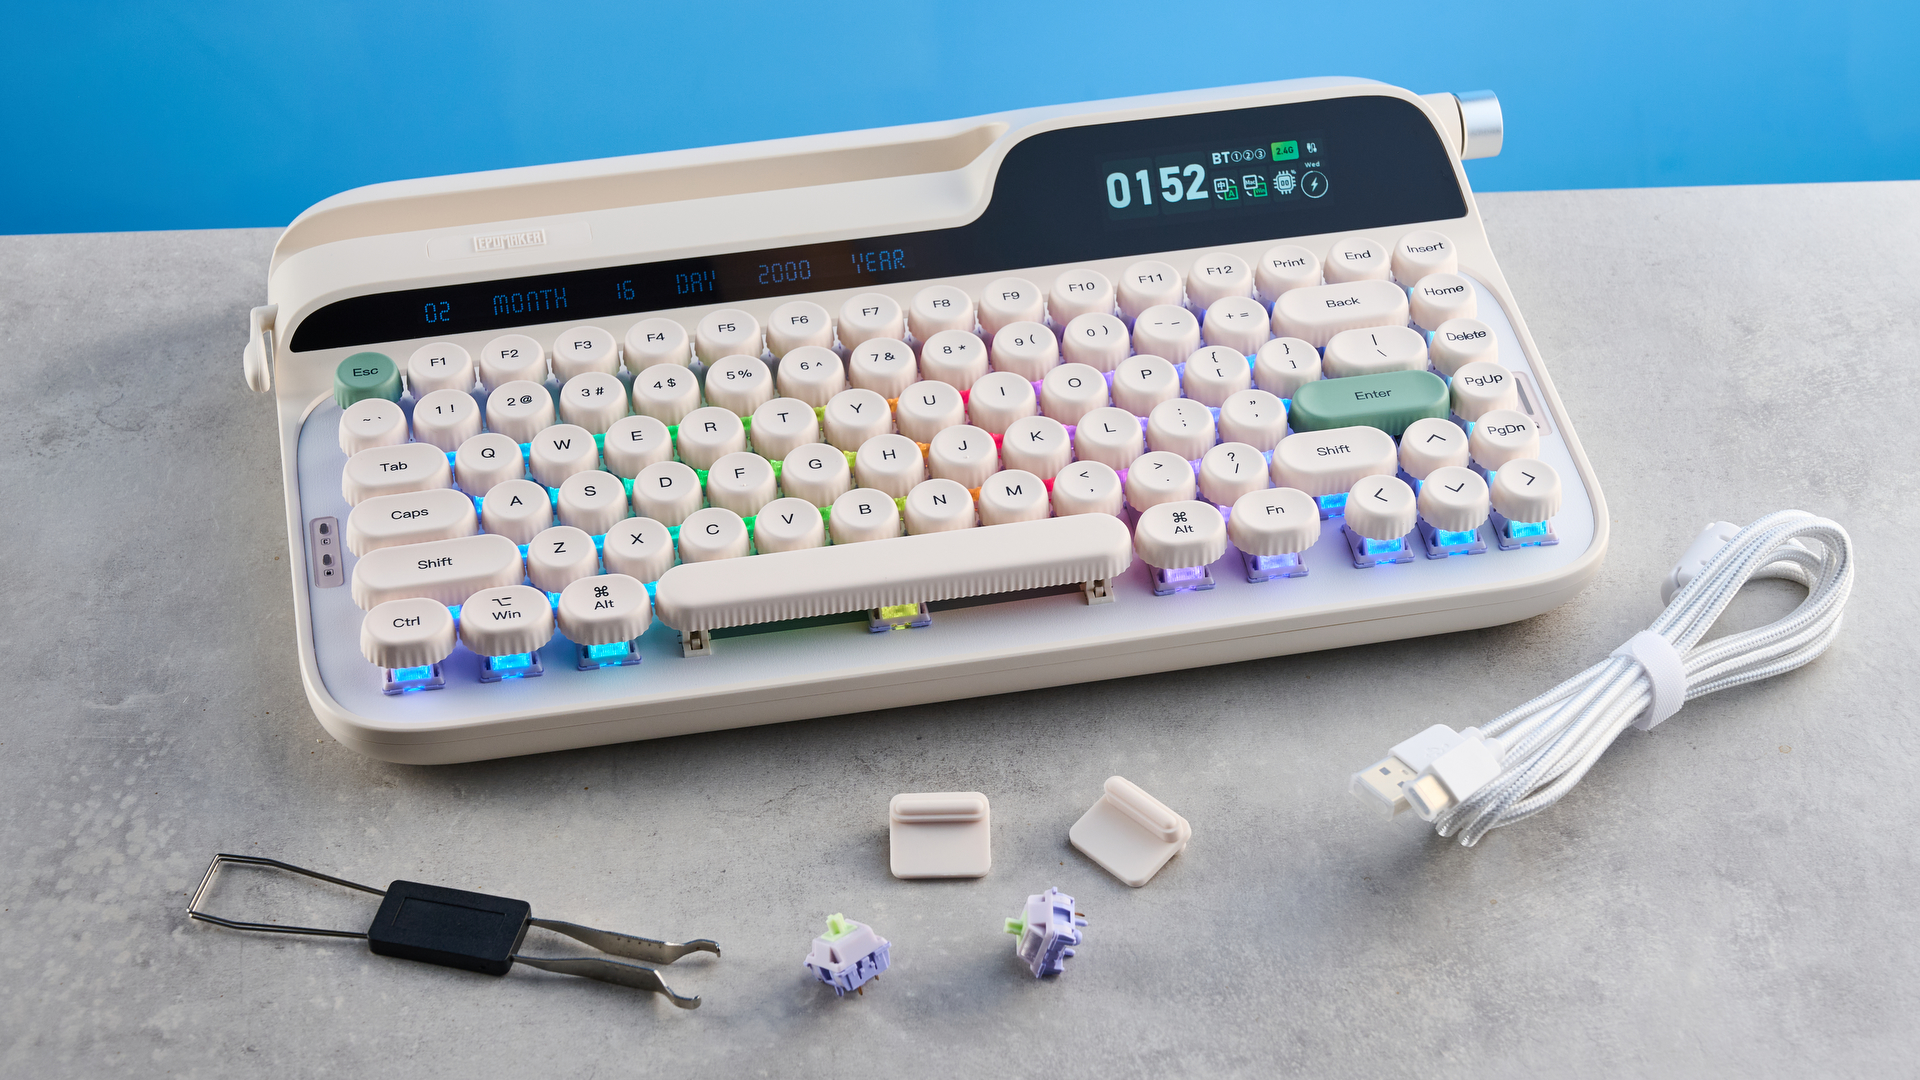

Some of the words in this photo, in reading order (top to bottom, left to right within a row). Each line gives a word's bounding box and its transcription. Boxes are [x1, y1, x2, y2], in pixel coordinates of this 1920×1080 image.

[1276, 146, 1294, 155] 2.4G
[1106, 164, 1209, 209] 0152
[1228, 190, 1235, 198] A
[1406, 241, 1444, 253] Insert
[1344, 249, 1372, 260] End
[1272, 257, 1306, 268] Print
[1206, 265, 1233, 276] F12
[1138, 273, 1163, 284] F11
[424, 301, 450, 323] 02
[493, 287, 568, 316] MONTH
[616, 280, 635, 300] 16
[676, 270, 716, 294] DAY
[758, 260, 811, 284] 2000
[852, 249, 906, 273] YEAR
[1068, 281, 1095, 292] F10
[1424, 285, 1465, 296] Home
[1002, 291, 1020, 301] F9
[1325, 296, 1360, 308] Back
[932, 298, 951, 309] F8
[862, 306, 879, 317] F7
[790, 315, 809, 325] F6
[717, 322, 736, 333] F5
[646, 332, 665, 343] F4
[1445, 330, 1487, 341] Delete
[573, 340, 593, 350] F3
[1282, 343, 1290, 355] }
[500, 348, 519, 359] F2
[1376, 349, 1387, 357] \
[430, 357, 446, 367] F1
[1289, 360, 1297, 369] ]
[352, 367, 379, 377] Esc
[1140, 369, 1153, 380] P
[1067, 377, 1082, 388] O
[1464, 374, 1503, 387] PgUp
[923, 394, 936, 406] U
[1354, 389, 1392, 401] Enter
[849, 403, 863, 414] Y
[776, 412, 789, 423] T
[704, 421, 718, 433] R
[1103, 422, 1117, 433] L
[1487, 424, 1526, 437] PgDn
[630, 430, 644, 442] E
[1030, 430, 1044, 442] K
[552, 438, 571, 451] W
[958, 440, 968, 451] J
[1316, 444, 1351, 457] Shift
[480, 447, 496, 459] Q
[882, 448, 897, 461] H
[379, 461, 408, 472] Tab
[808, 458, 823, 470] G
[734, 467, 745, 479] F
[658, 476, 673, 488] D
[584, 485, 597, 497] S
[1005, 484, 1023, 497] M
[509, 495, 523, 507] A
[932, 494, 947, 506] N
[390, 508, 429, 520] Caps
[858, 503, 872, 515] B
[1265, 505, 1285, 515] Fn
[780, 513, 794, 525] V
[705, 523, 720, 536] C
[1174, 521, 1195, 535] Alt
[630, 532, 645, 545] X
[553, 541, 567, 554] Z
[417, 556, 453, 570] Shift
[594, 596, 615, 611] Alt
[392, 615, 421, 628] Ctrl
[491, 610, 522, 621] Win
